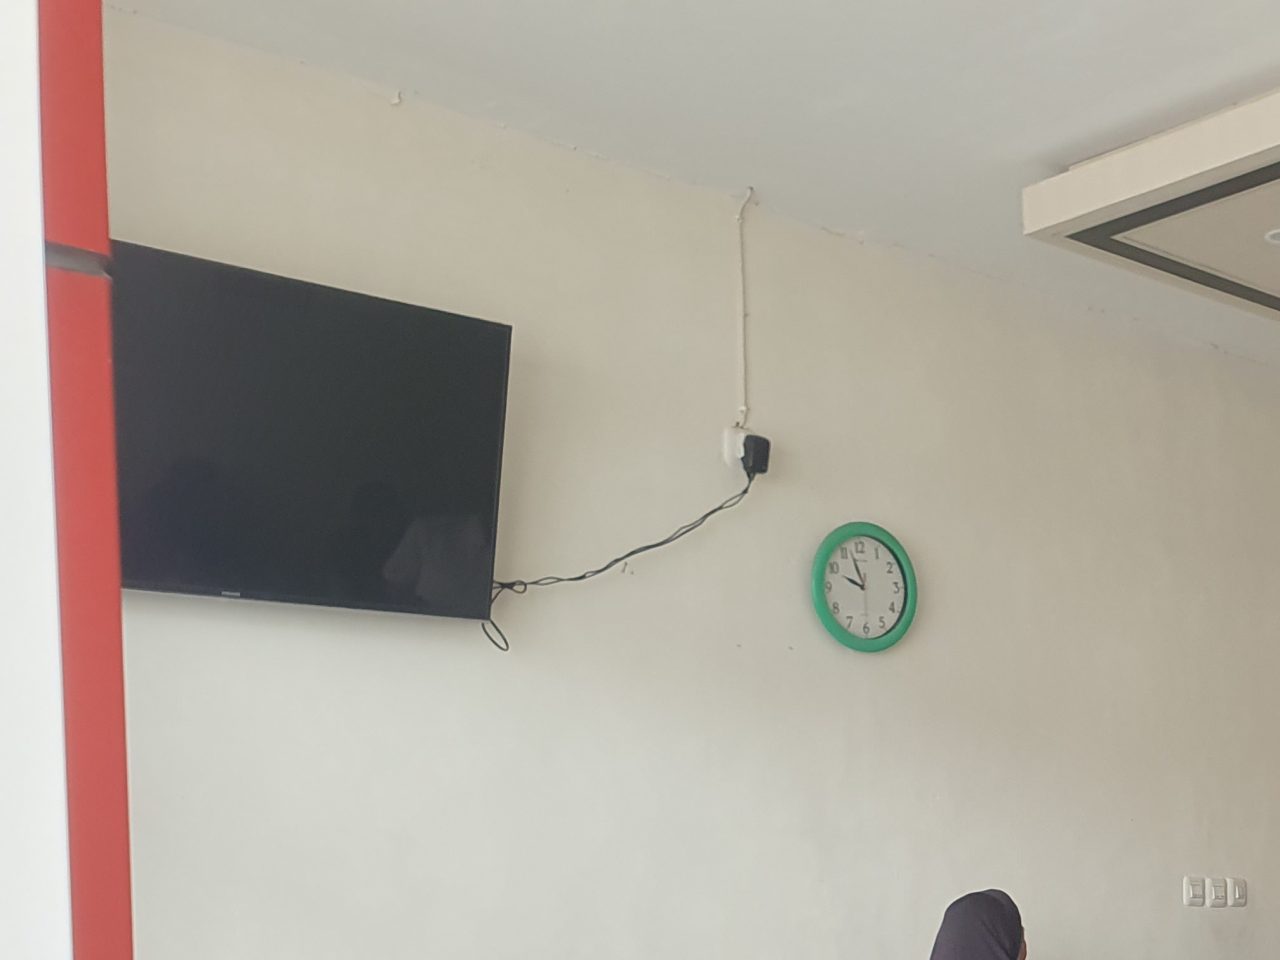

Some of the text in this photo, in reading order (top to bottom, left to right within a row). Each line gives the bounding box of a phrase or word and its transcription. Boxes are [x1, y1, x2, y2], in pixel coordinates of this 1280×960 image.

[840, 547, 848, 560] 11
[854, 541, 865, 554] 12
[828, 561, 839, 574] 10
[886, 561, 893, 574] 2
[825, 581, 832, 594] 9
[893, 581, 900, 594] 3
[832, 602, 840, 614] 8
[888, 601, 895, 614] 4
[846, 615, 853, 628] 7
[878, 616, 886, 628] 5
[862, 622, 870, 635] 6
